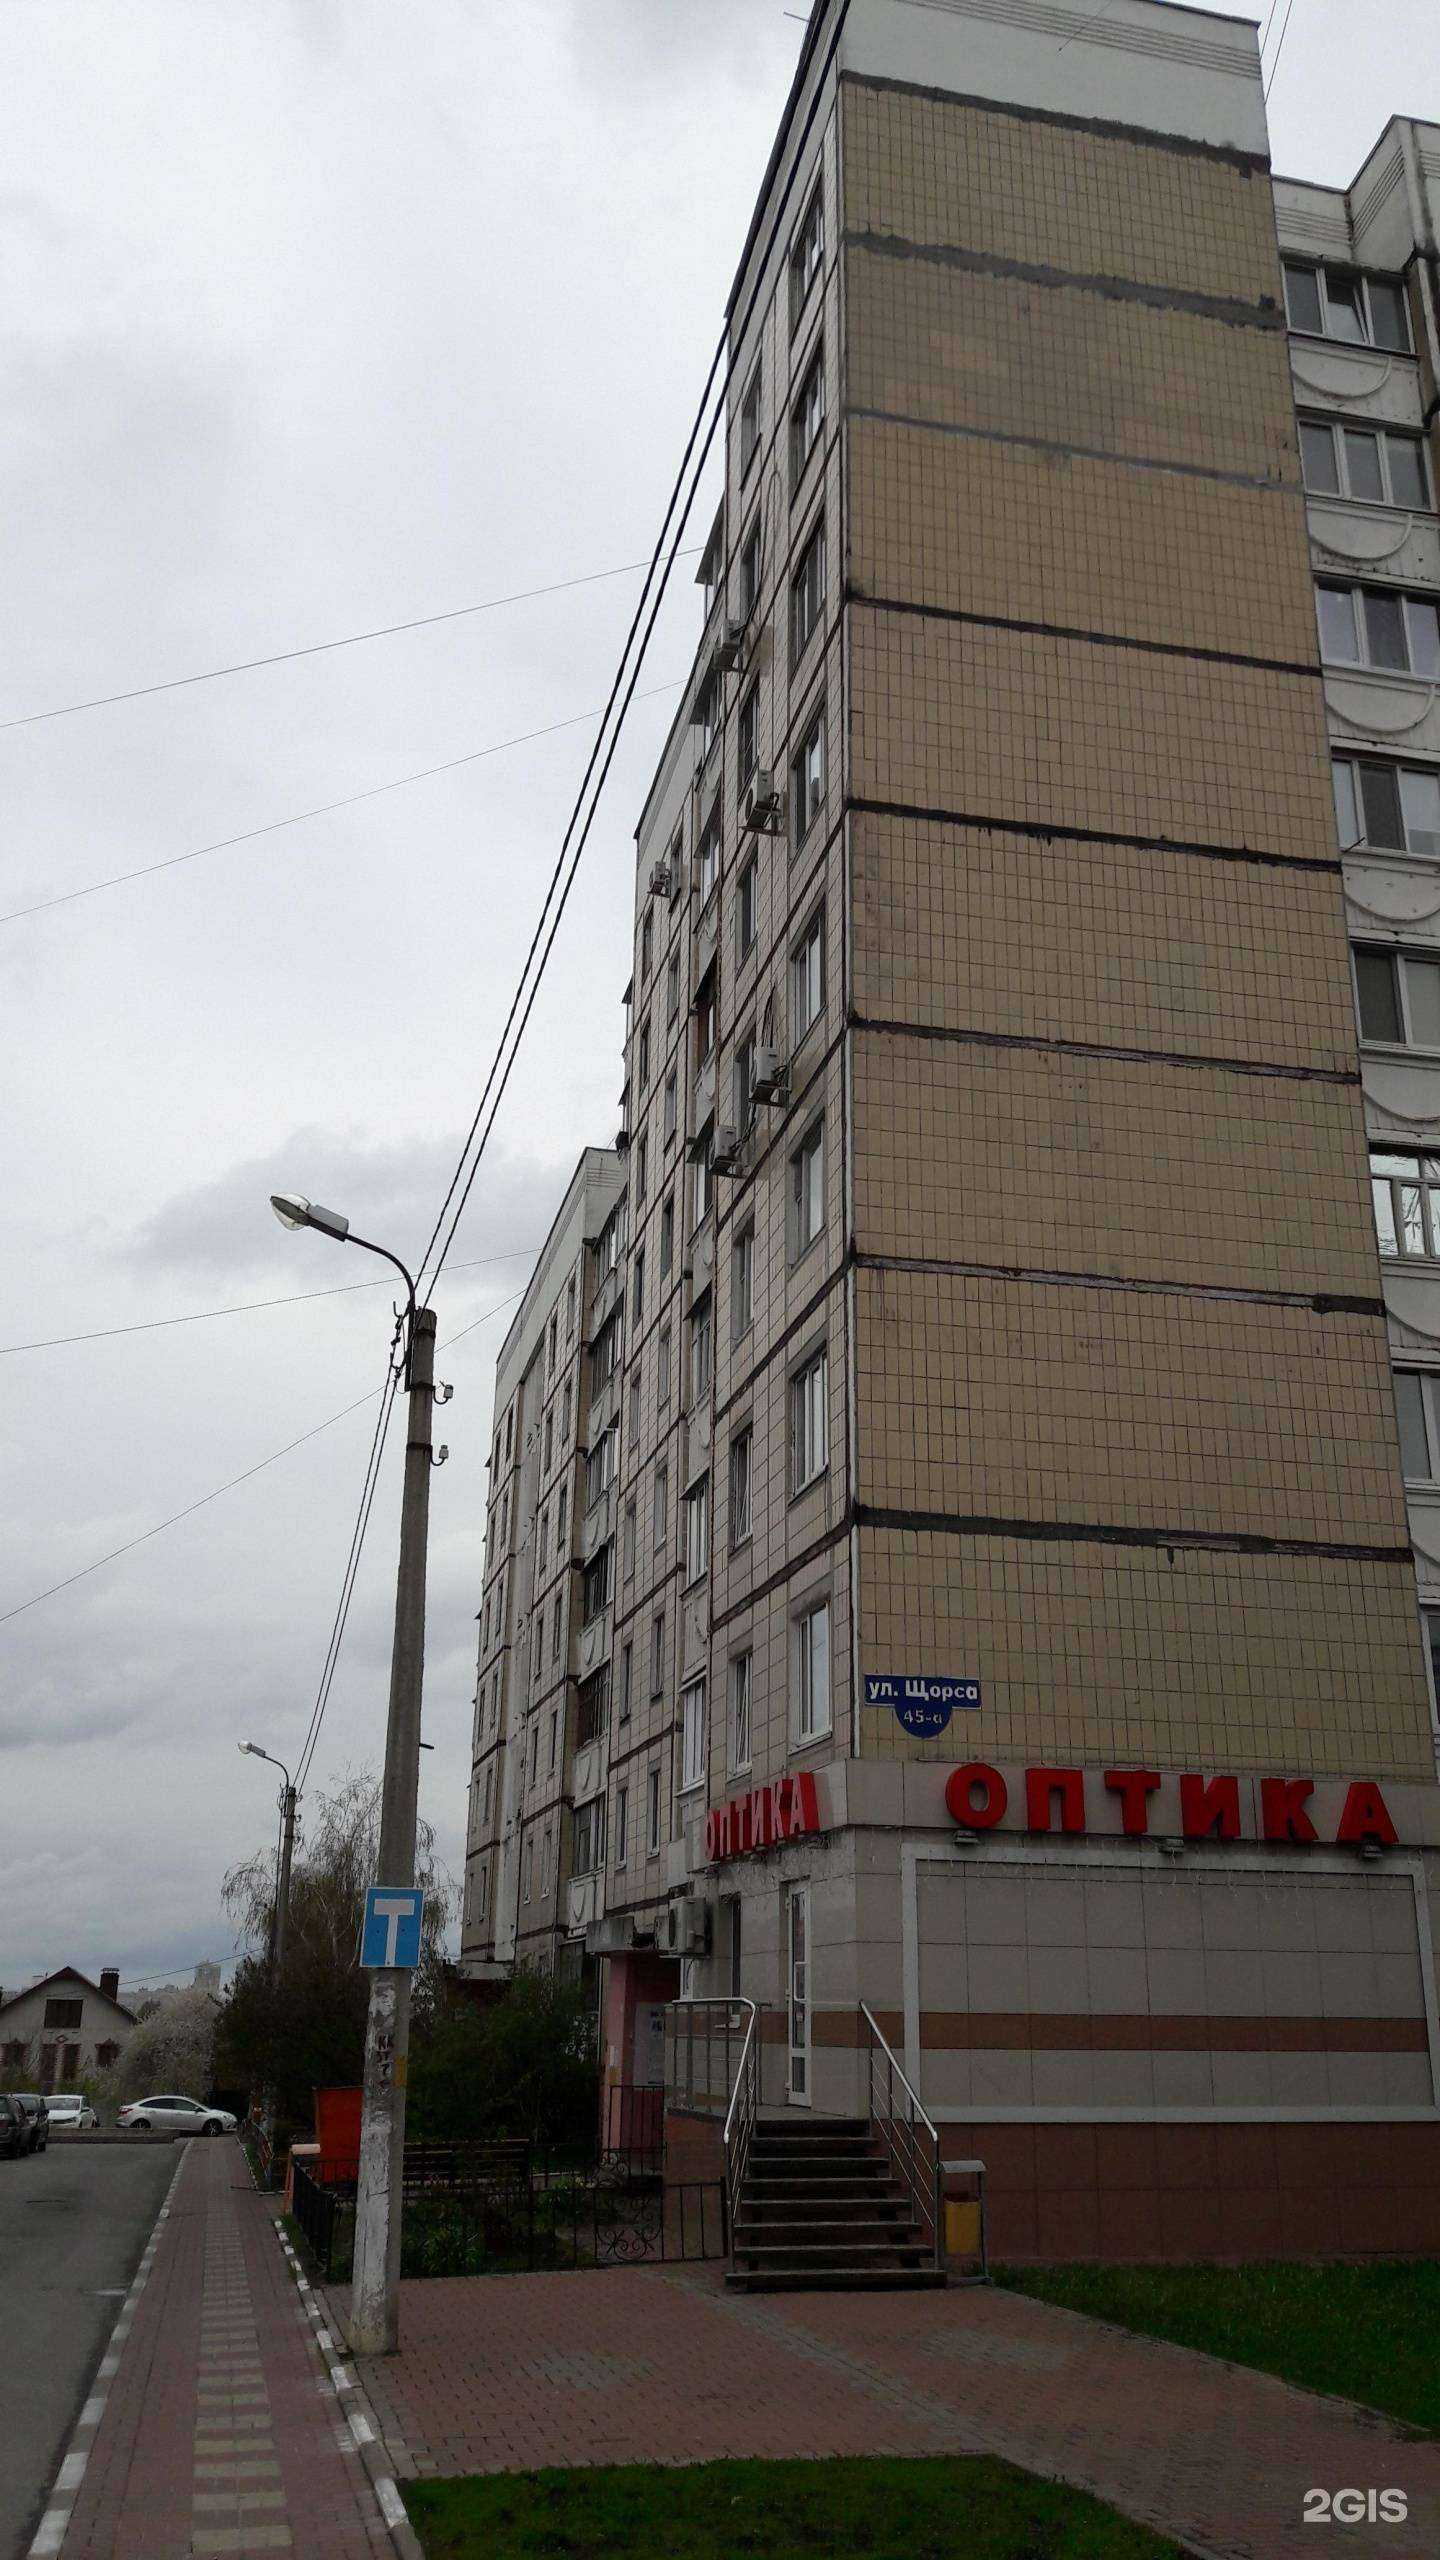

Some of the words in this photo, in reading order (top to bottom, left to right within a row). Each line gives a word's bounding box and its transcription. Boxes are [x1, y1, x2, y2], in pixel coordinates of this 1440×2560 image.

[868, 1681, 899, 1700] ул.
[905, 1679, 978, 1702] Щорса
[705, 1771, 821, 1862] ОПТИКА
[945, 1763, 1399, 1845] ОПТИКА
